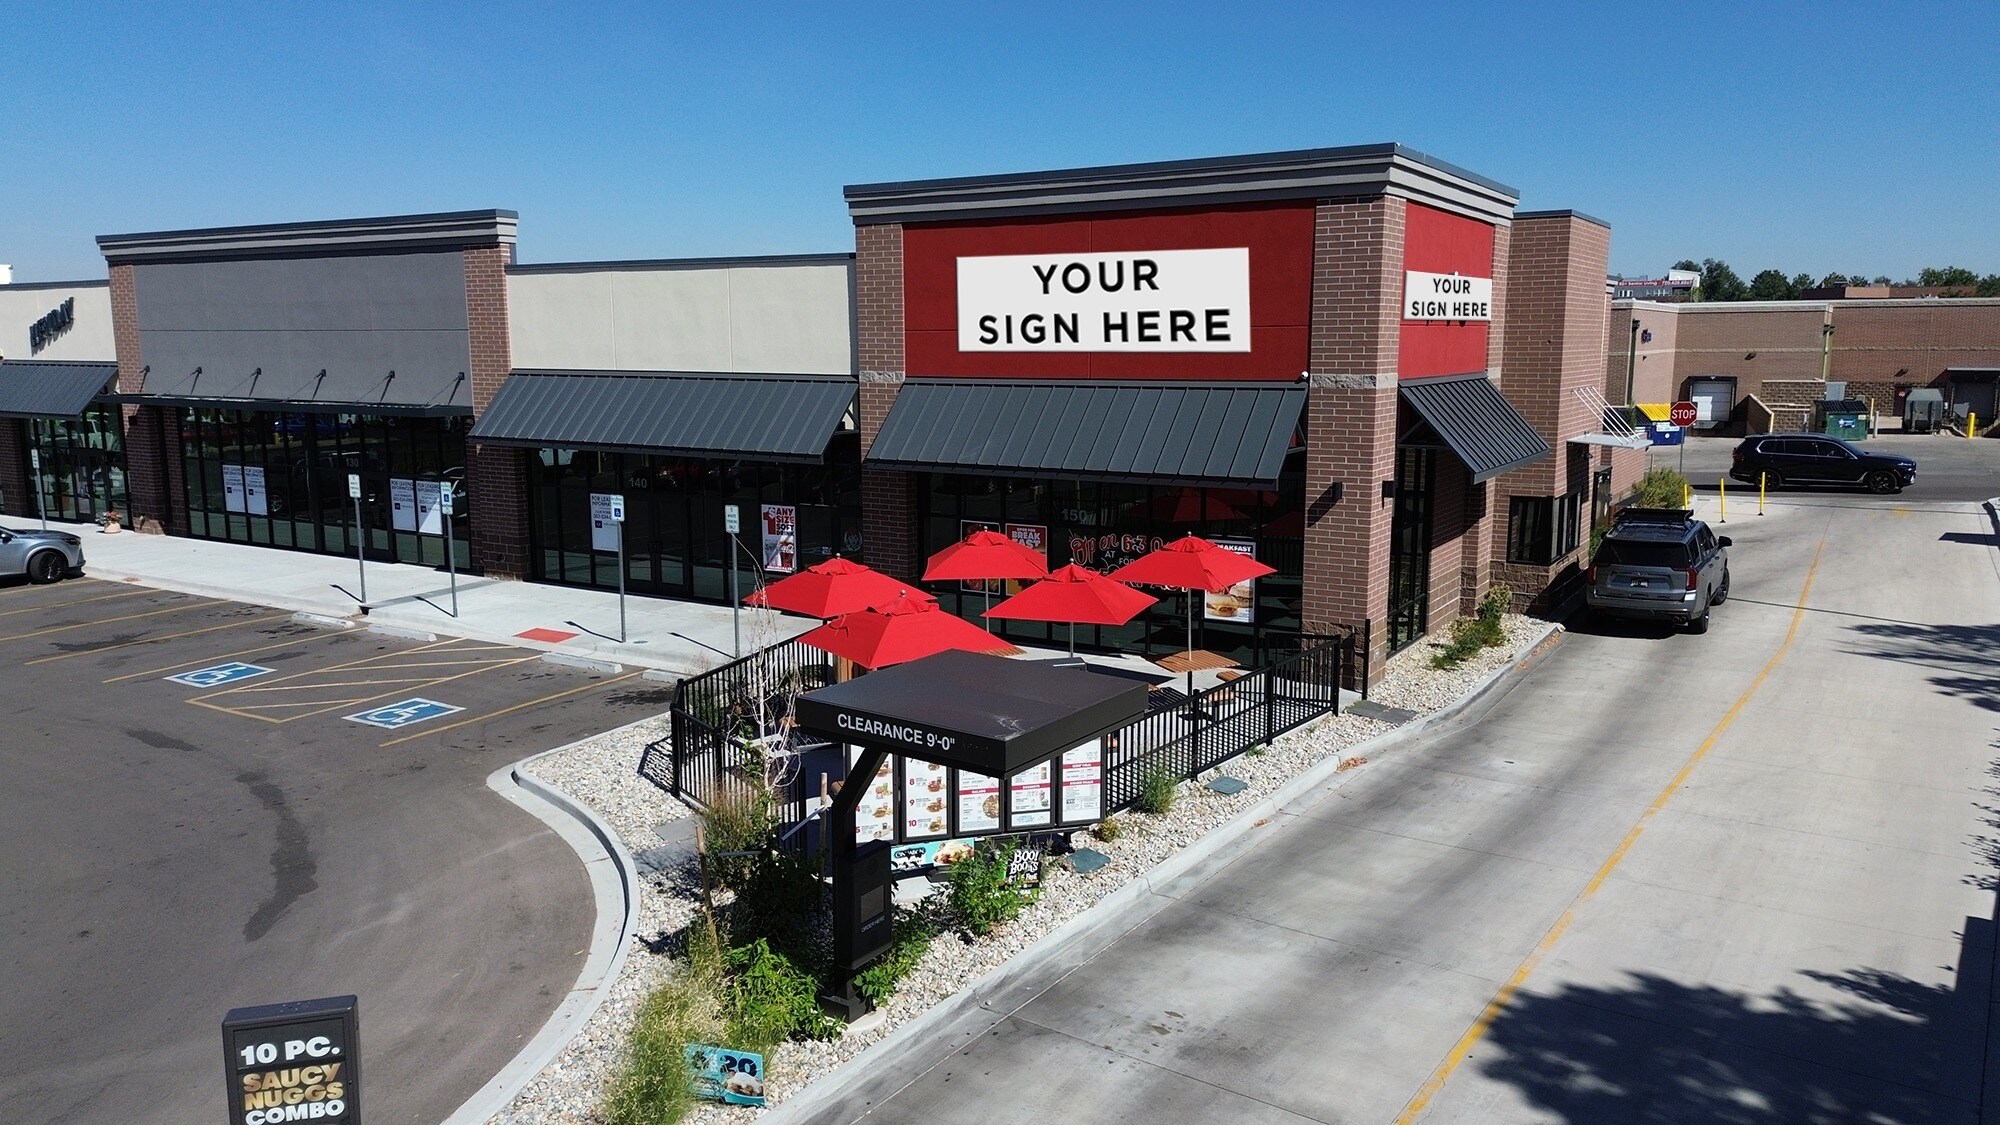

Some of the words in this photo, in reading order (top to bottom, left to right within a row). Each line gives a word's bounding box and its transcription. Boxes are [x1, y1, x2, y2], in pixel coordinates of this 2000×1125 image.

[1032, 259, 1160, 295] YOUR
[1433, 278, 1470, 294] YOUR
[1411, 301, 1446, 316] SIGN
[1453, 302, 1487, 316] HERE
[978, 313, 1080, 345] SIGN
[1102, 308, 1232, 343] HERE
[1671, 410, 1696, 419] STOP
[346, 458, 359, 468] 130
[629, 477, 648, 488] 140
[776, 508, 793, 516] ANY
[776, 516, 794, 524] SIZE
[776, 523, 794, 531] SOFT
[1011, 531, 1040, 540] BREAK
[1105, 550, 1116, 558] AT
[837, 713, 923, 745] CLEARANCE
[926, 733, 955, 750] 9'-0"
[1013, 850, 1039, 863] BOO!
[240, 1043, 278, 1065] 10
[284, 1036, 340, 1060] PC.
[243, 1062, 341, 1092] SAUCY
[244, 1081, 344, 1111] NUGGS
[245, 1099, 345, 1125] COMBO
